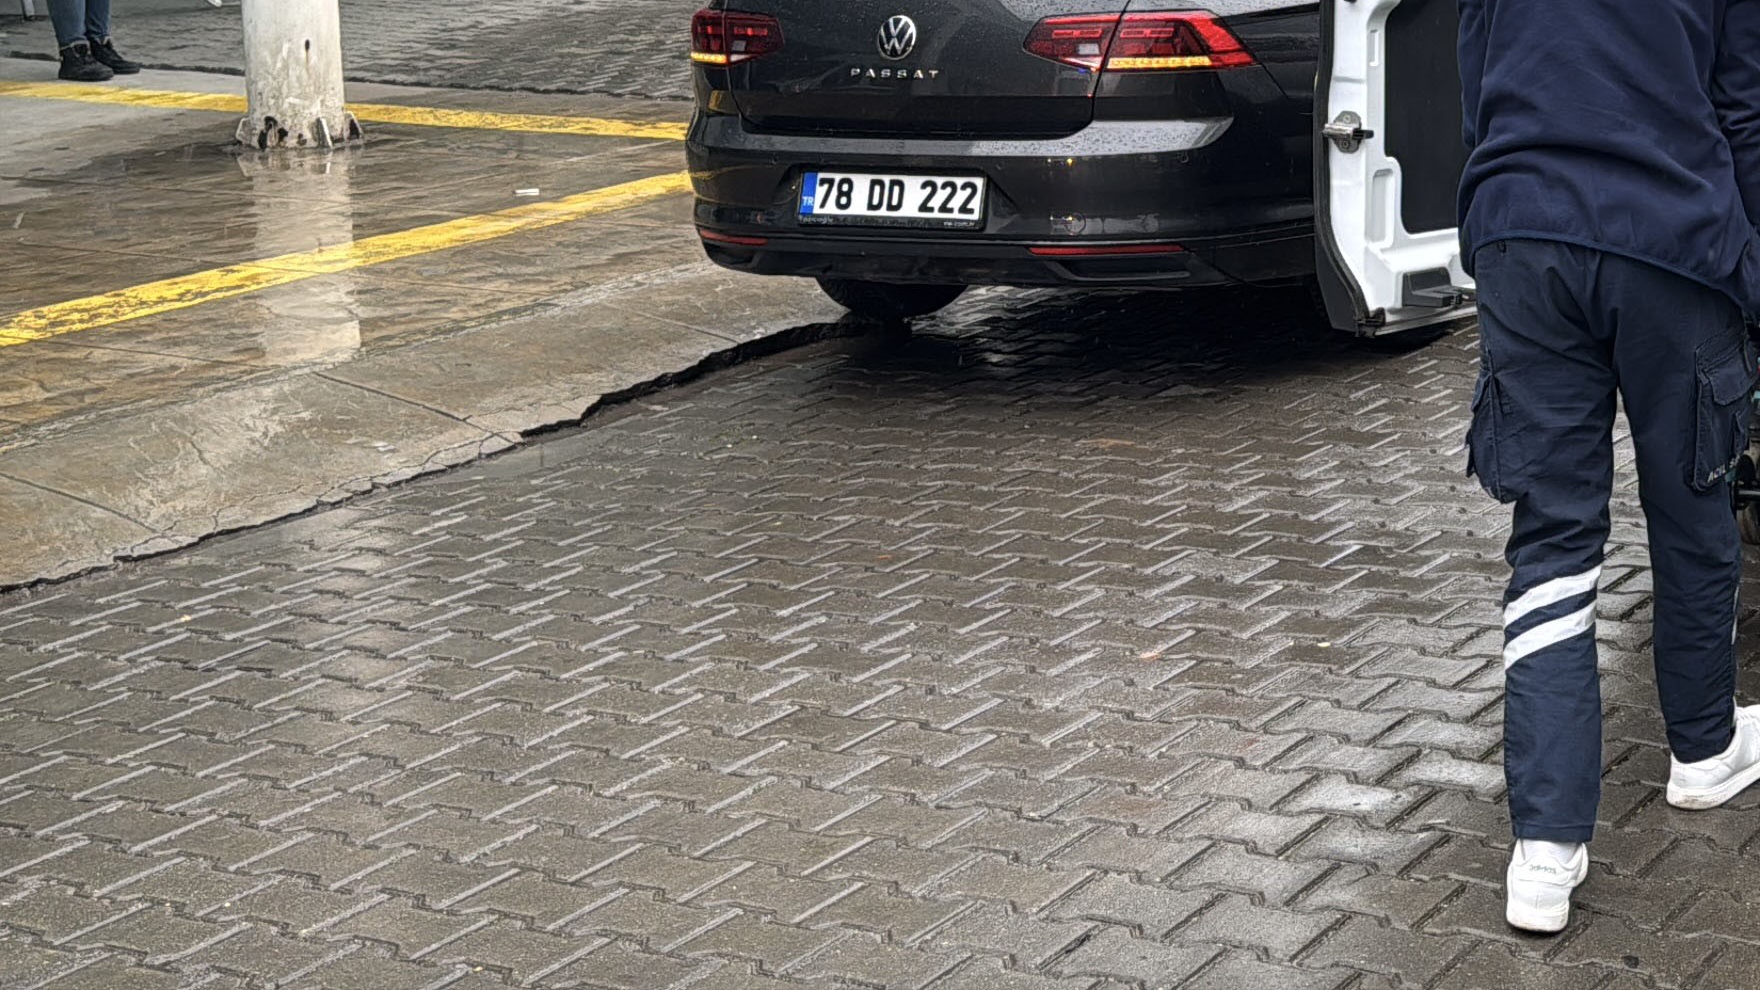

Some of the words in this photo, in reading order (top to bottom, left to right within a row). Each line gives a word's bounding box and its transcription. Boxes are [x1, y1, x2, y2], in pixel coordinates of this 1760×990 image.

[850, 68, 939, 79] PASSAT
[802, 196, 814, 206] TR
[818, 177, 854, 210] 78
[866, 178, 905, 212] DD
[918, 179, 978, 215] 222
